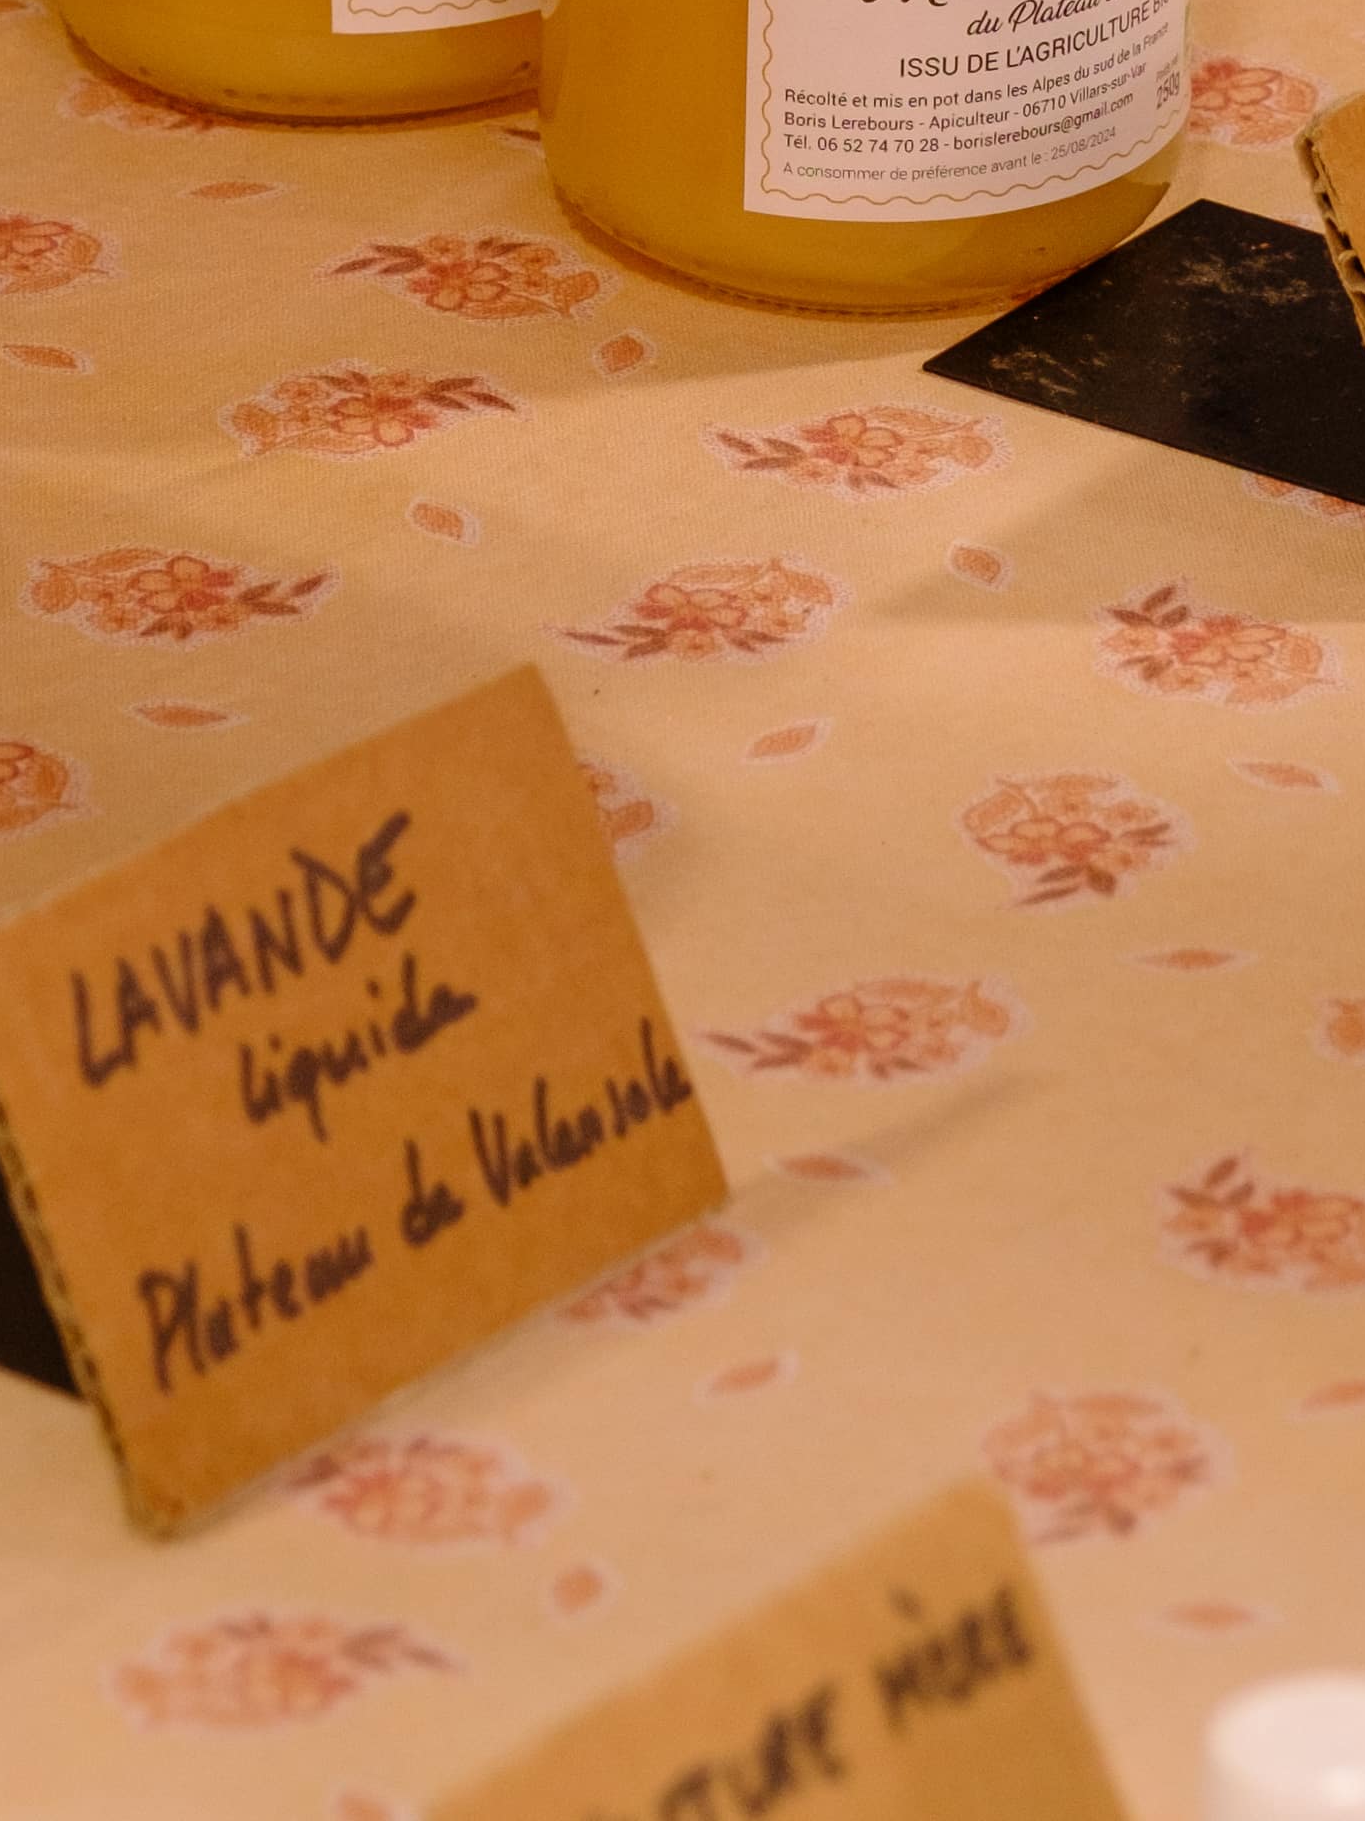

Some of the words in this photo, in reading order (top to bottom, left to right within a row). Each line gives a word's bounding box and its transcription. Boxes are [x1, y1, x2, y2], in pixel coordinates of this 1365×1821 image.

[966, 9, 1003, 36] du
[900, 55, 959, 78] ISSU
[967, 50, 1000, 74] DE
